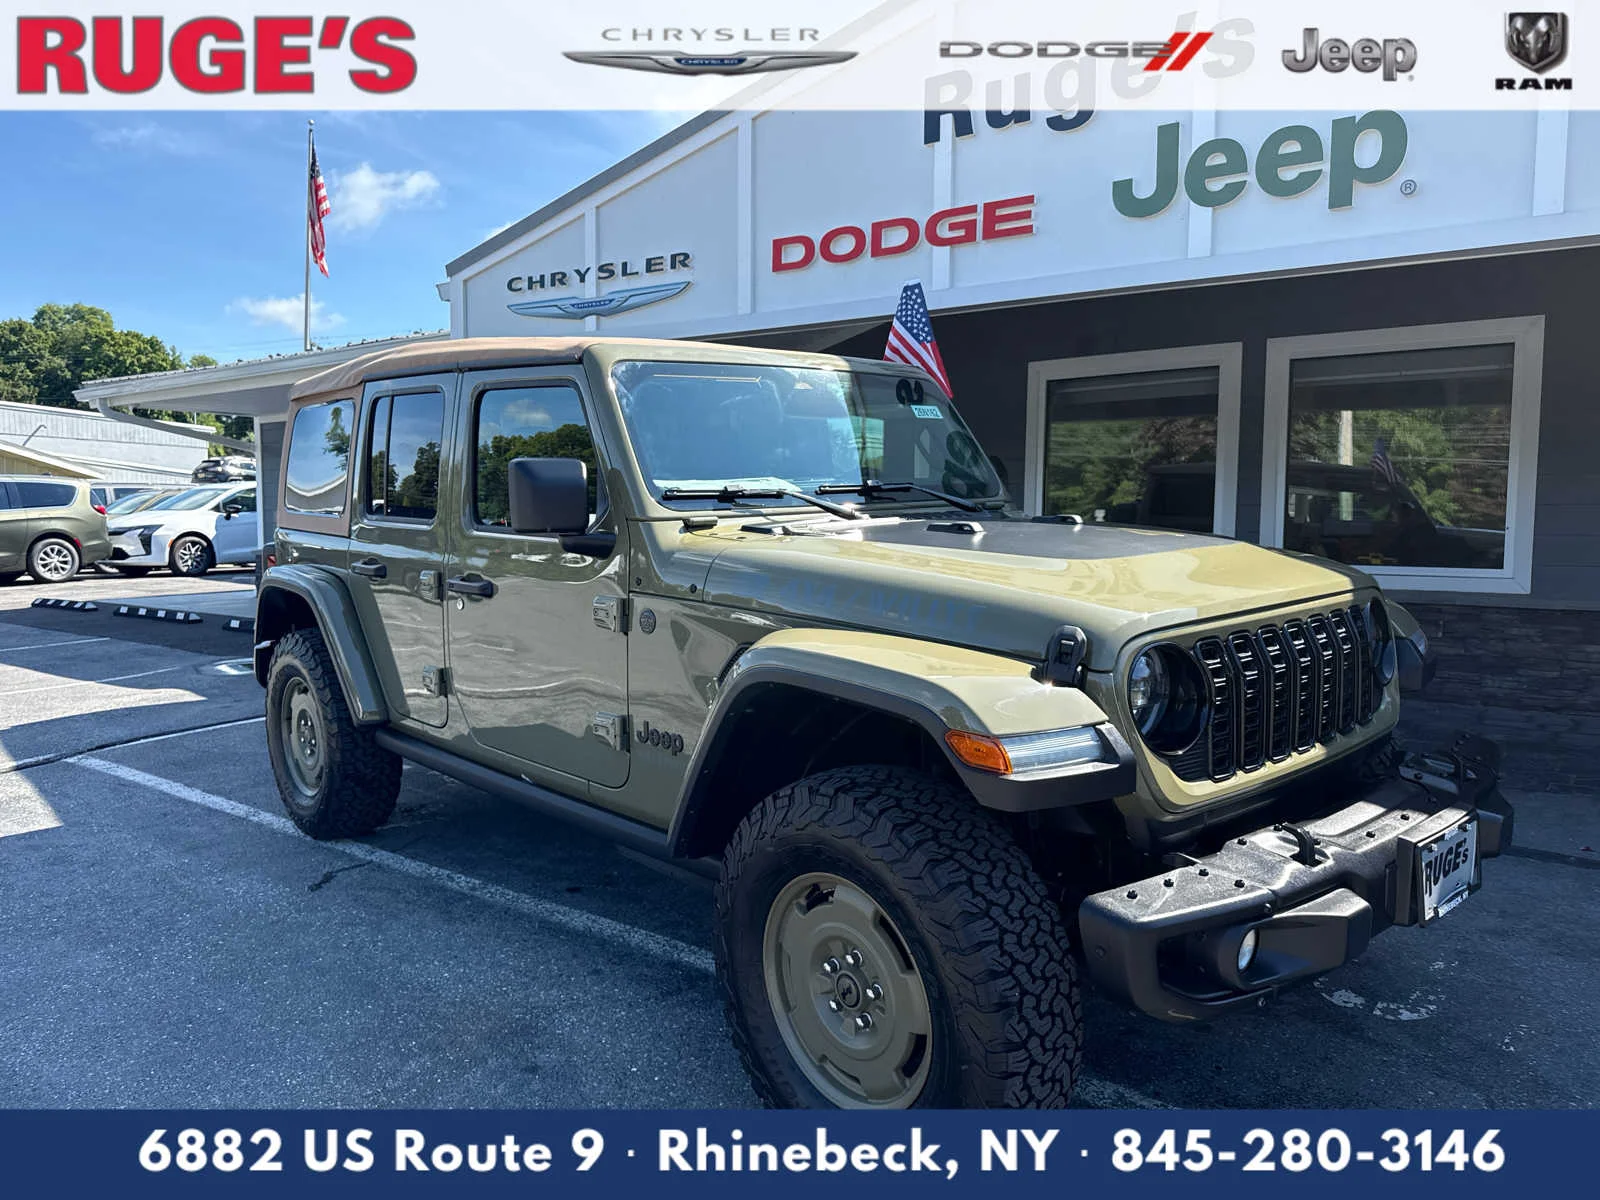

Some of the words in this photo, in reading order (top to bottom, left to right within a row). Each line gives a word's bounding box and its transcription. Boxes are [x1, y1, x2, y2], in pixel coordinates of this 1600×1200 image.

[1111, 109, 1410, 219] Jeep
[771, 195, 1036, 274] DODGE
[506, 252, 692, 293] CHRYSLER
[636, 720, 685, 757] Jeep
